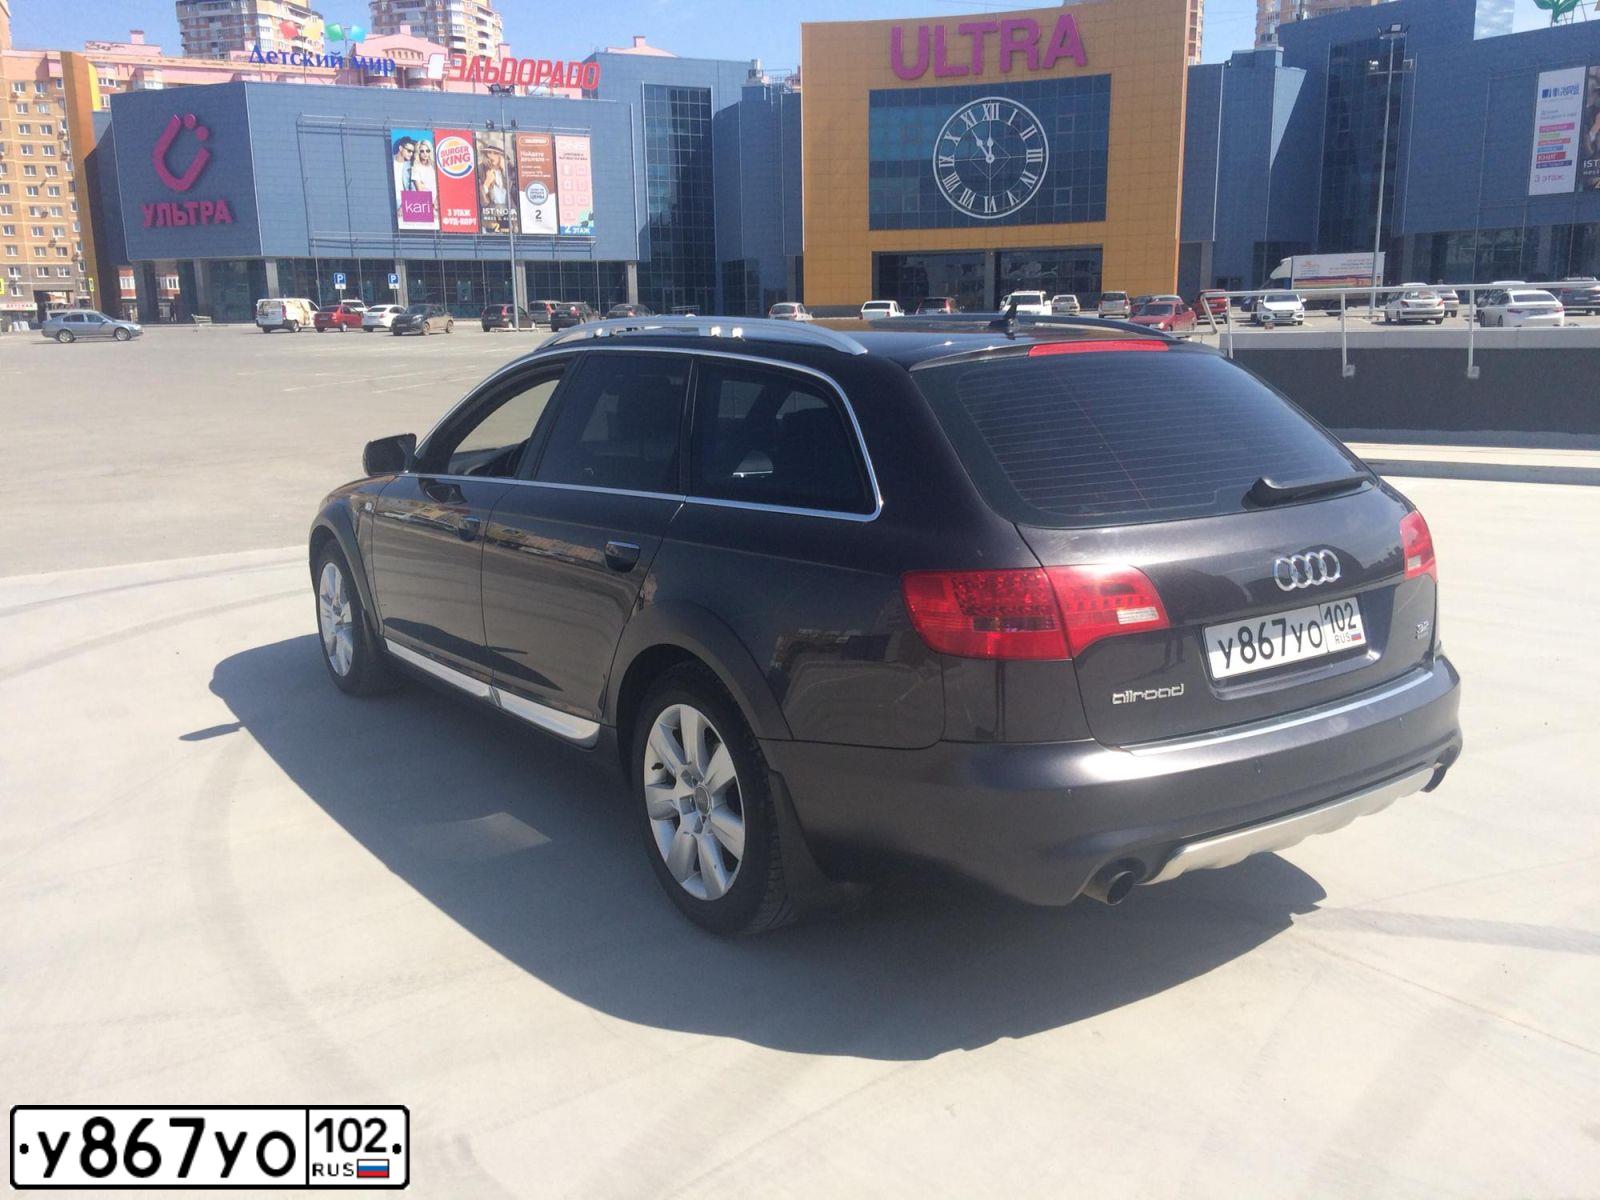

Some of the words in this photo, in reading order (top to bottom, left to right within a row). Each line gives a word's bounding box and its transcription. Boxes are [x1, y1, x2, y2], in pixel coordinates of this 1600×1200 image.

[890, 13, 1088, 80] ULTRA
[248, 44, 344, 69] Детский
[349, 55, 396, 77] мир
[440, 145, 469, 158] BURGER
[442, 153, 471, 167] KING
[142, 199, 232, 227] УЛЬТРА
[404, 200, 430, 213] kari
[535, 209, 542, 220] 2
[1324, 601, 1358, 632] 102
[1334, 633, 1352, 645] RUS
[1112, 683, 1185, 705] allroad
